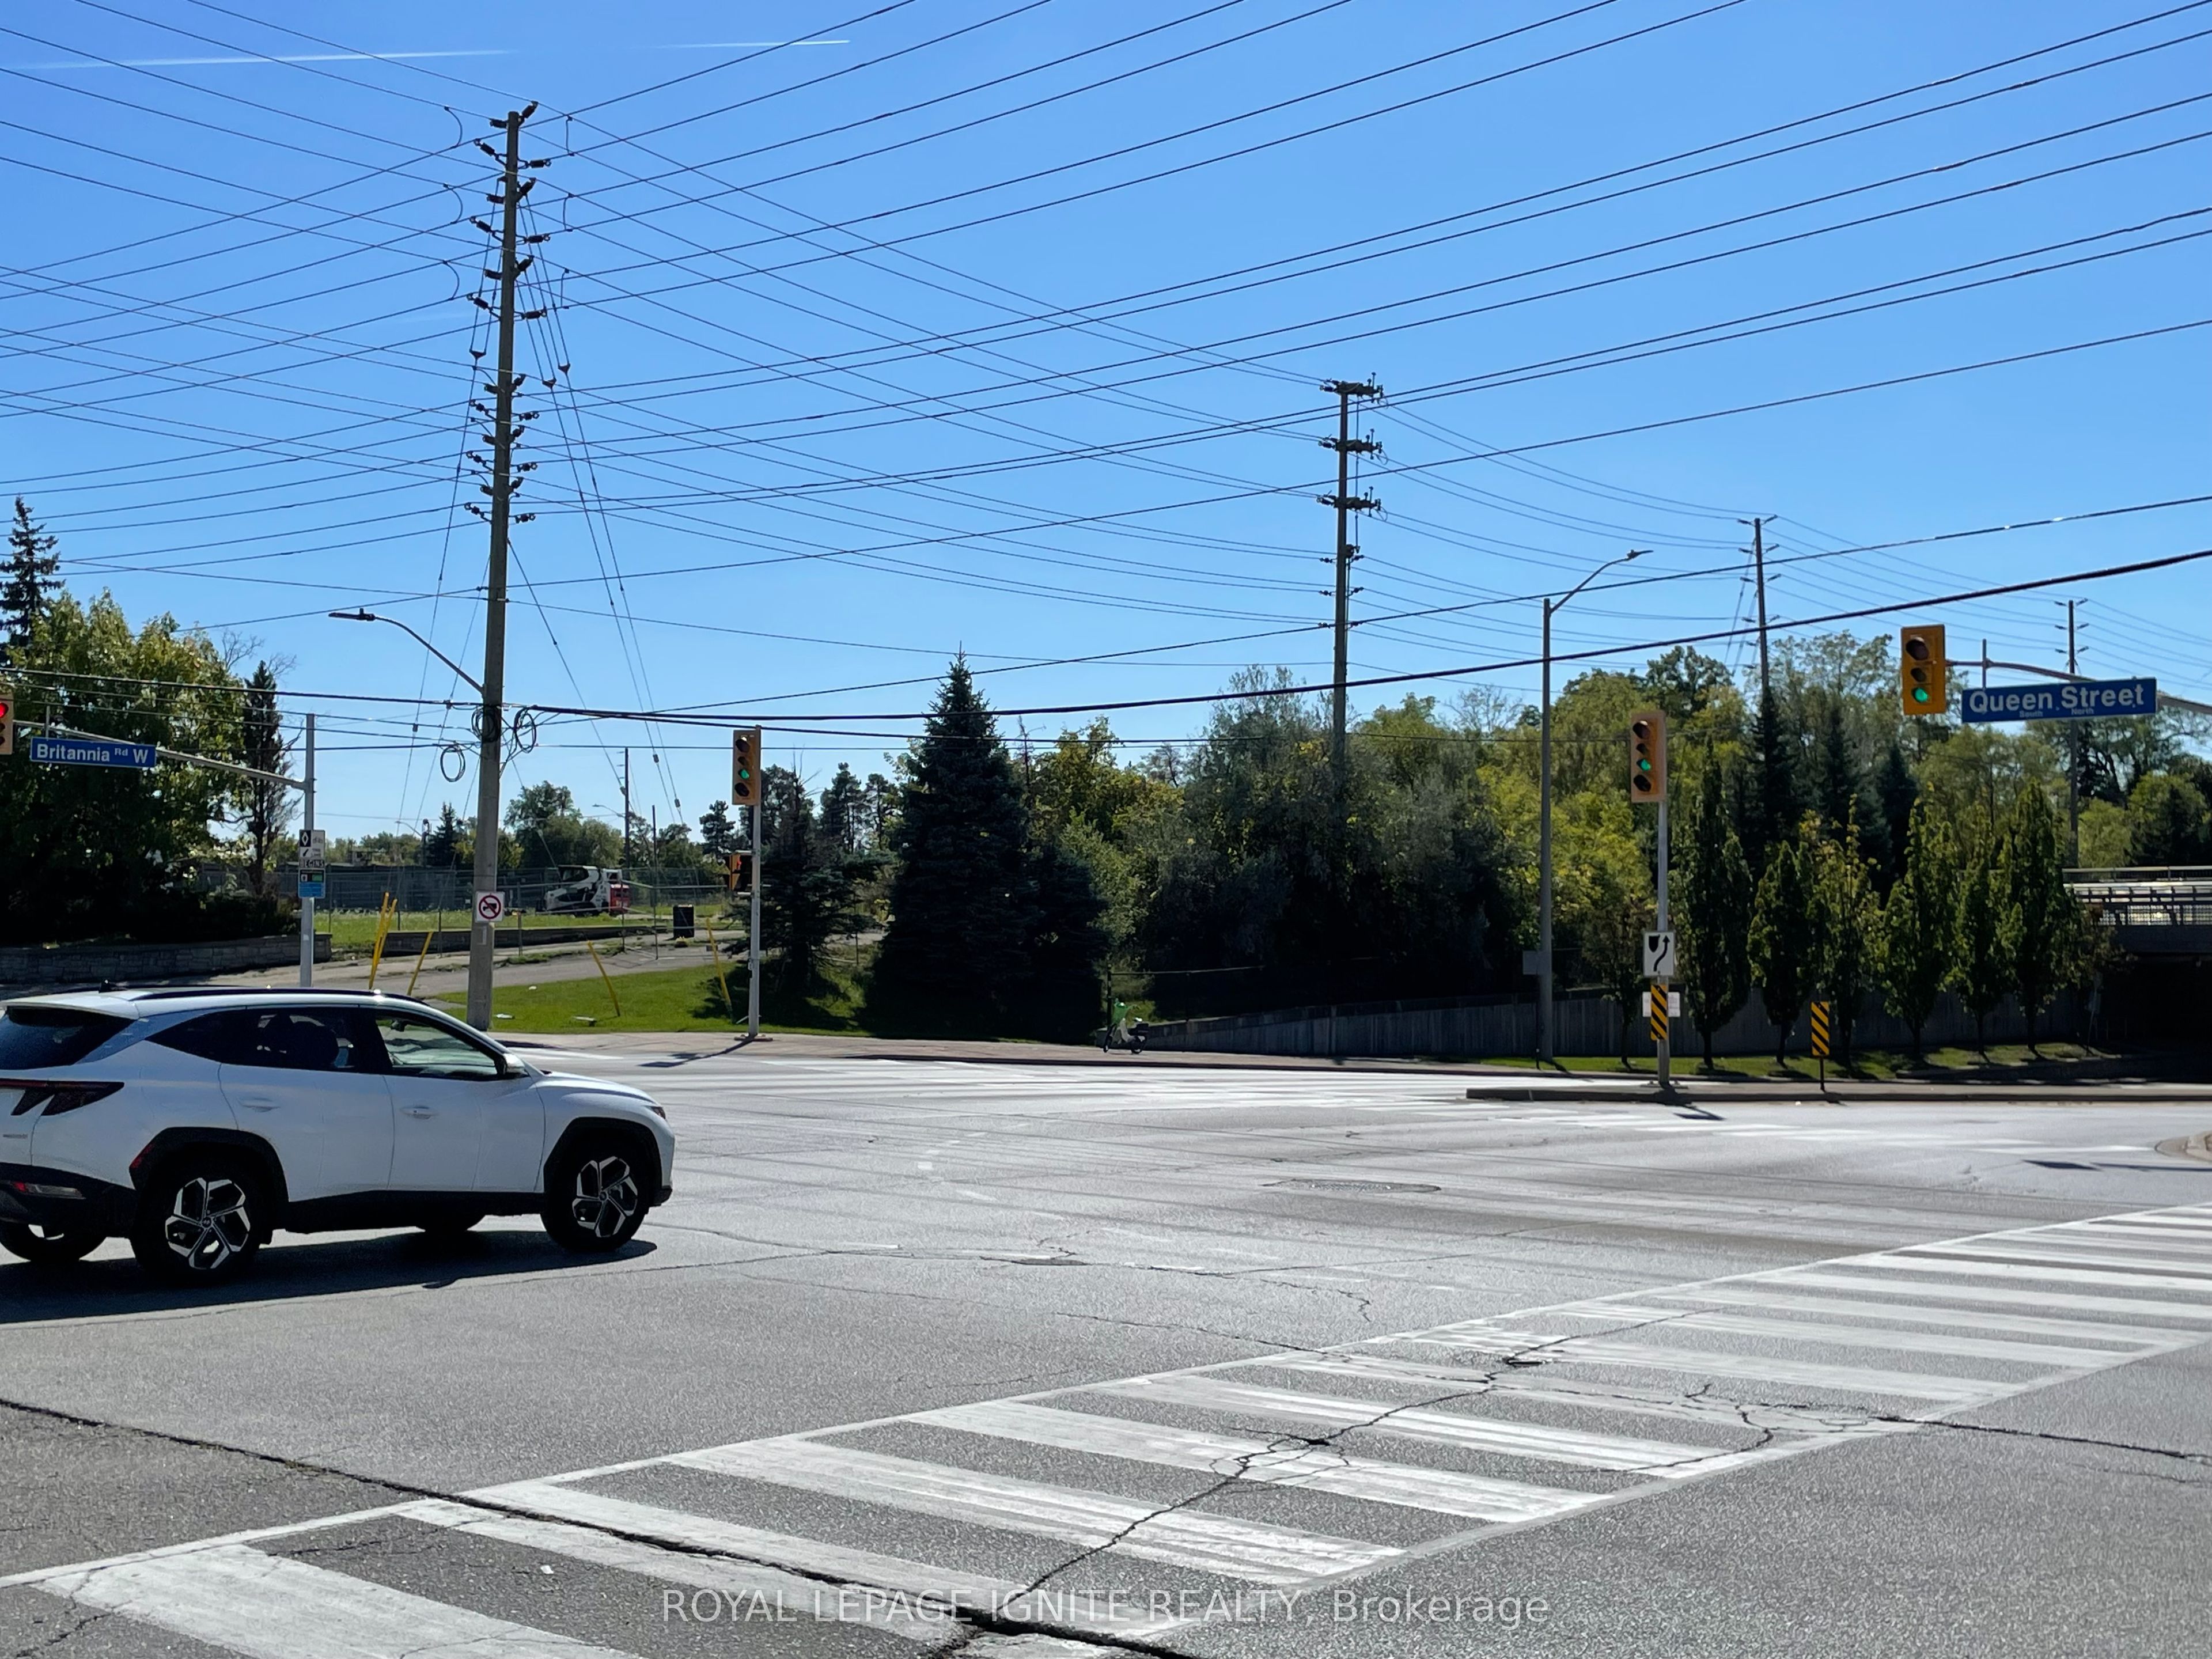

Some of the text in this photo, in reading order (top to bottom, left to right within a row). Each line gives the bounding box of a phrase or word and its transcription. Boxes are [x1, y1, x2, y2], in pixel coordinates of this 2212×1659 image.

[1969, 684, 2143, 714] Queen Street
[2019, 707, 2094, 718] South North
[37, 743, 148, 763] Britannia Rd W
